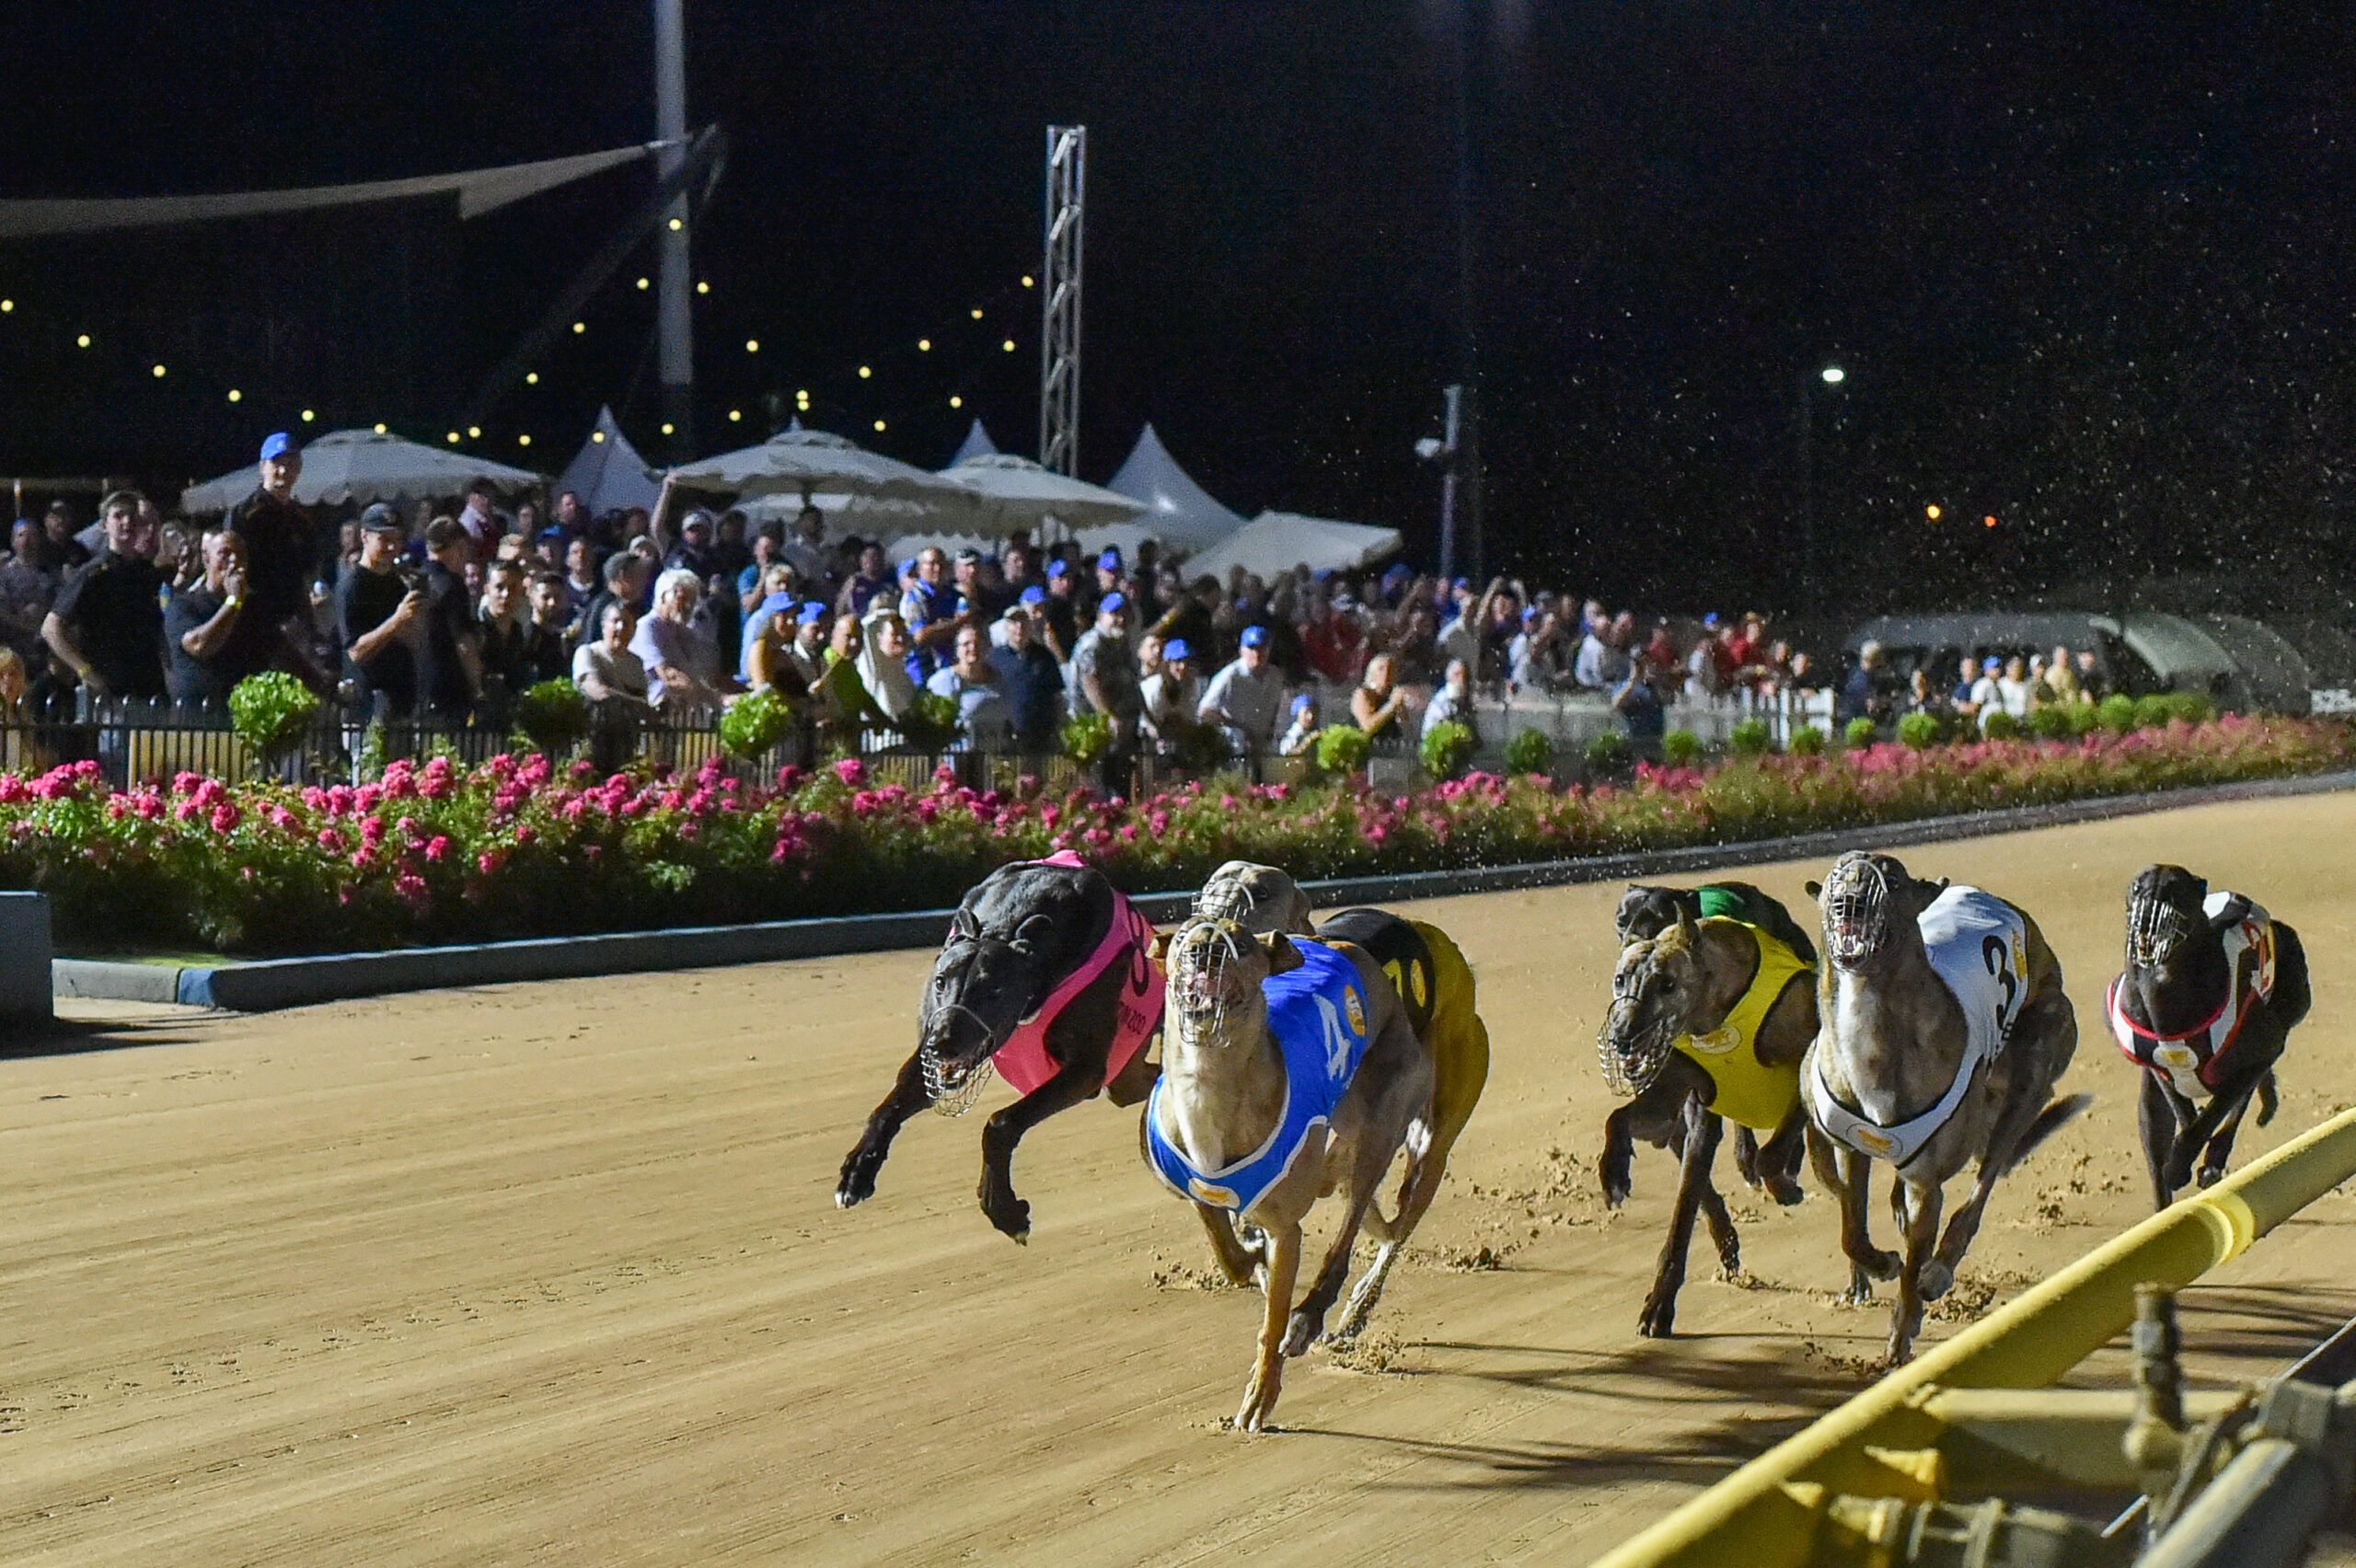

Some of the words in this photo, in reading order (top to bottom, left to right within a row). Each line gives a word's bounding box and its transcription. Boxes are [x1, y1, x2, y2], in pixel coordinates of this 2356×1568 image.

[1128, 905, 1149, 997] 8
[1982, 934, 2015, 1031] 3
[1312, 992, 1352, 1081] 4
